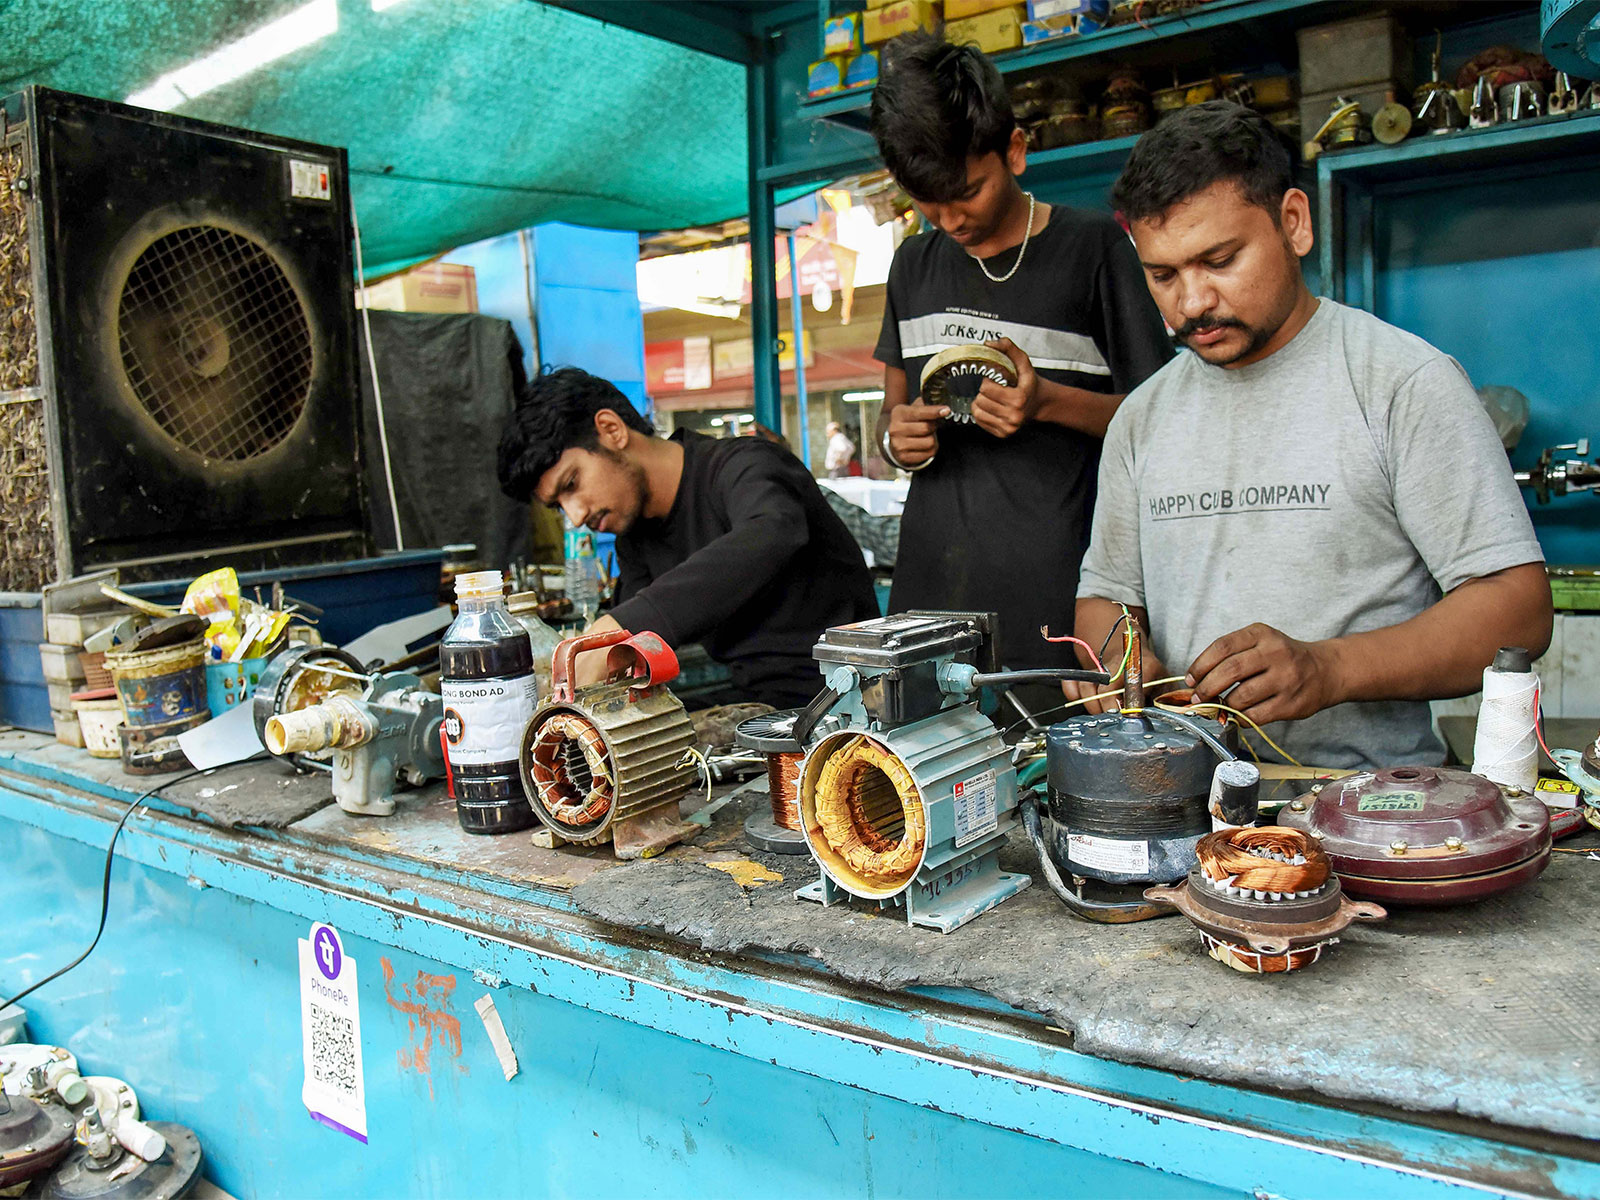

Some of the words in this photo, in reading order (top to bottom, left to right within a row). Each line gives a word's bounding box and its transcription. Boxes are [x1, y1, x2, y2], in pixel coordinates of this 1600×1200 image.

[1149, 492, 1196, 516] HAPPY
[1199, 489, 1234, 511] CUB
[1239, 483, 1331, 507] COMPANY
[459, 688, 487, 699] BOND
[489, 687, 504, 697] AD
[311, 977, 350, 1007] PhonePe
